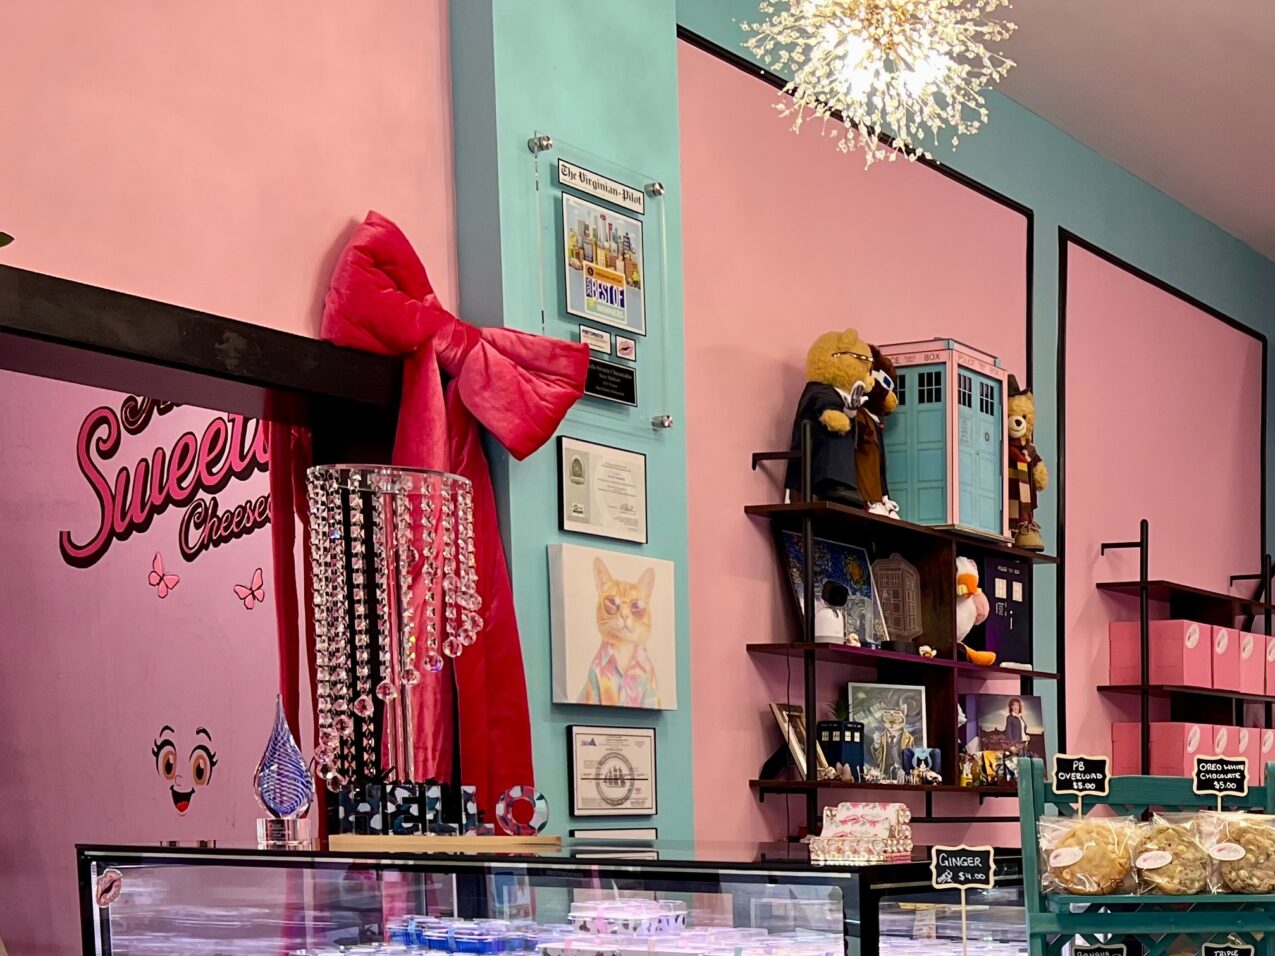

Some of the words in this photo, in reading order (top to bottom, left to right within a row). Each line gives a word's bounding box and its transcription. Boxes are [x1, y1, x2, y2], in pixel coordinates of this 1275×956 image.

[561, 164, 577, 181] The
[578, 171, 642, 206] Virginian-Pilot
[592, 279, 611, 304] BEST
[612, 285, 625, 309] OF
[59, 405, 272, 569] Sweeti
[1072, 760, 1086, 771] PB
[1200, 763, 1222, 772] OREO
[1058, 772, 1103, 780] OVERLOAD
[1201, 772, 1241, 780] CHOCOLATE
[1072, 781, 1096, 790] $5.00
[1213, 781, 1237, 790] $5.00
[340, 784, 550, 838] HELLO
[939, 853, 983, 867] GINGER
[958, 871, 986, 882] $4.00
